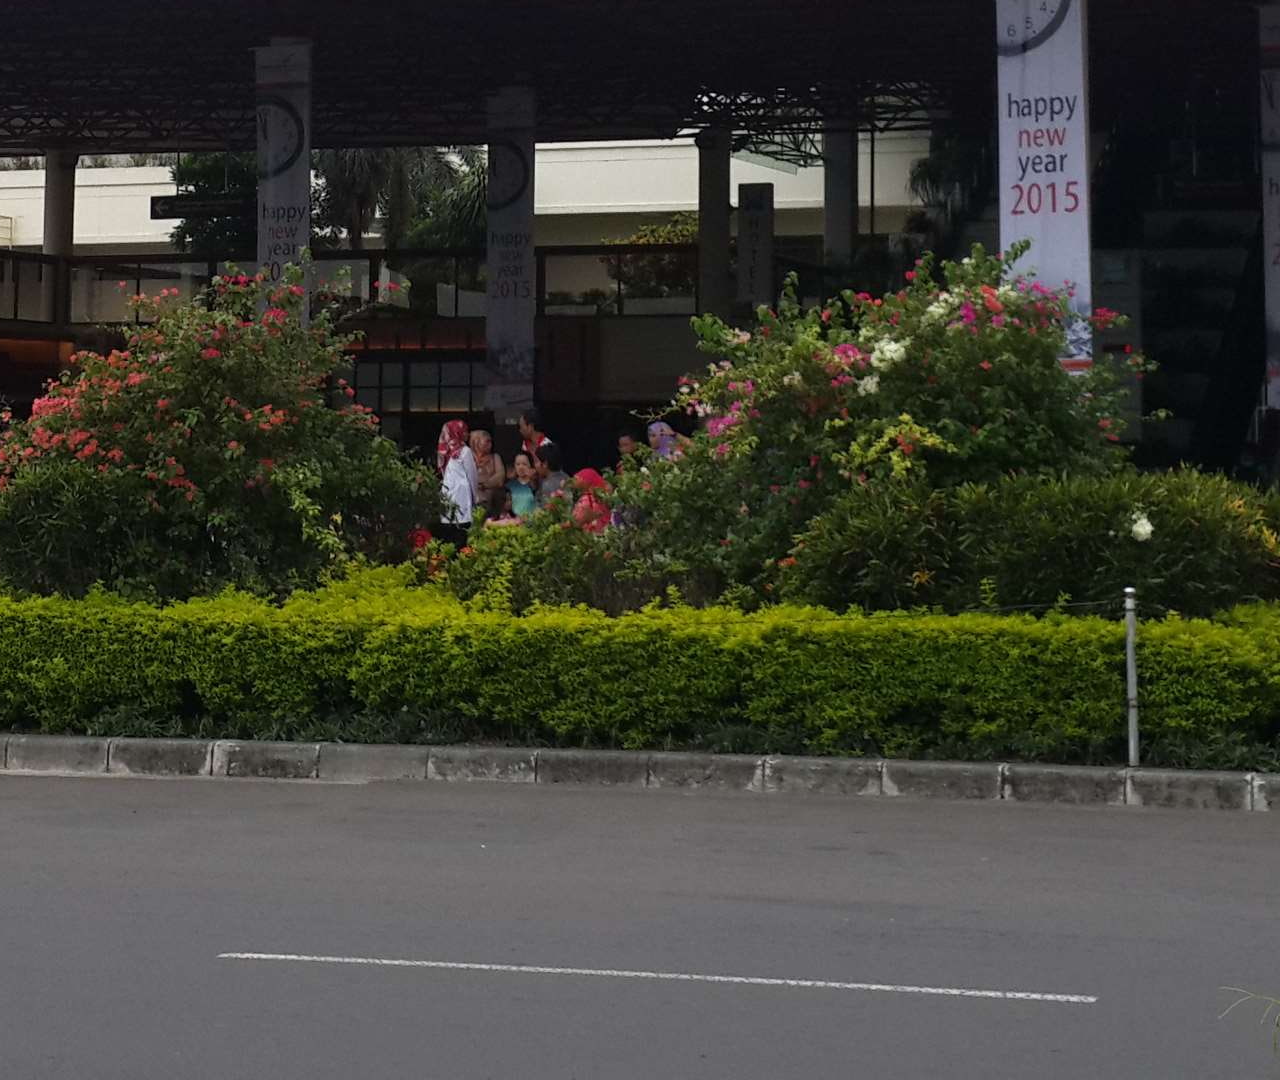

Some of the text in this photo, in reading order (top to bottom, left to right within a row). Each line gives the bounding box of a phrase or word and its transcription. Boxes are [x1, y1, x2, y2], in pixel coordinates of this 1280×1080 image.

[1007, 92, 1078, 122] happy
[1018, 126, 1066, 149] new
[1018, 153, 1068, 182] year
[262, 202, 306, 223] happy
[1010, 181, 1080, 216] 2015
